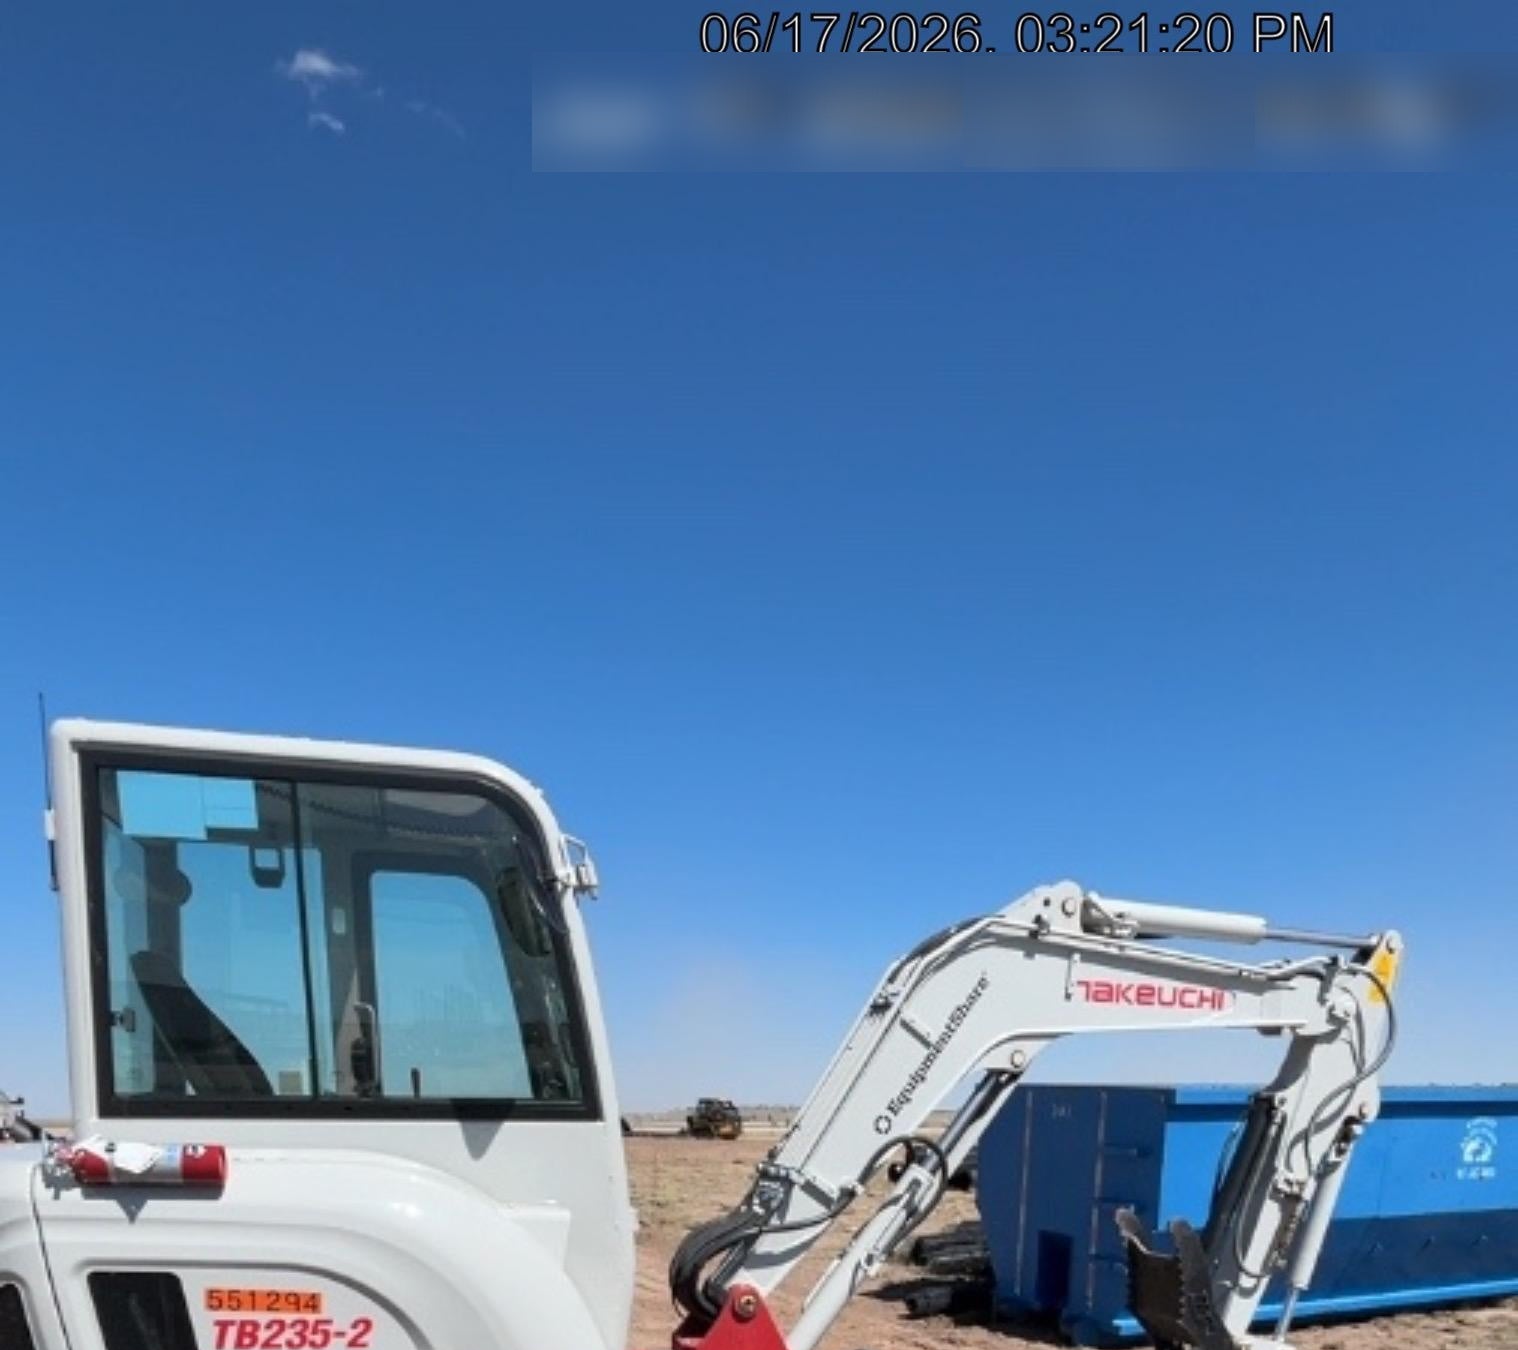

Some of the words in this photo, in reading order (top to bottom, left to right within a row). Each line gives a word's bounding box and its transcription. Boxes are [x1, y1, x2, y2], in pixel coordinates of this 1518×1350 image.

[887, 976, 989, 1117] EquipmentShare
[207, 1289, 320, 1313] 551294
[213, 1318, 373, 1350] TB235-2
